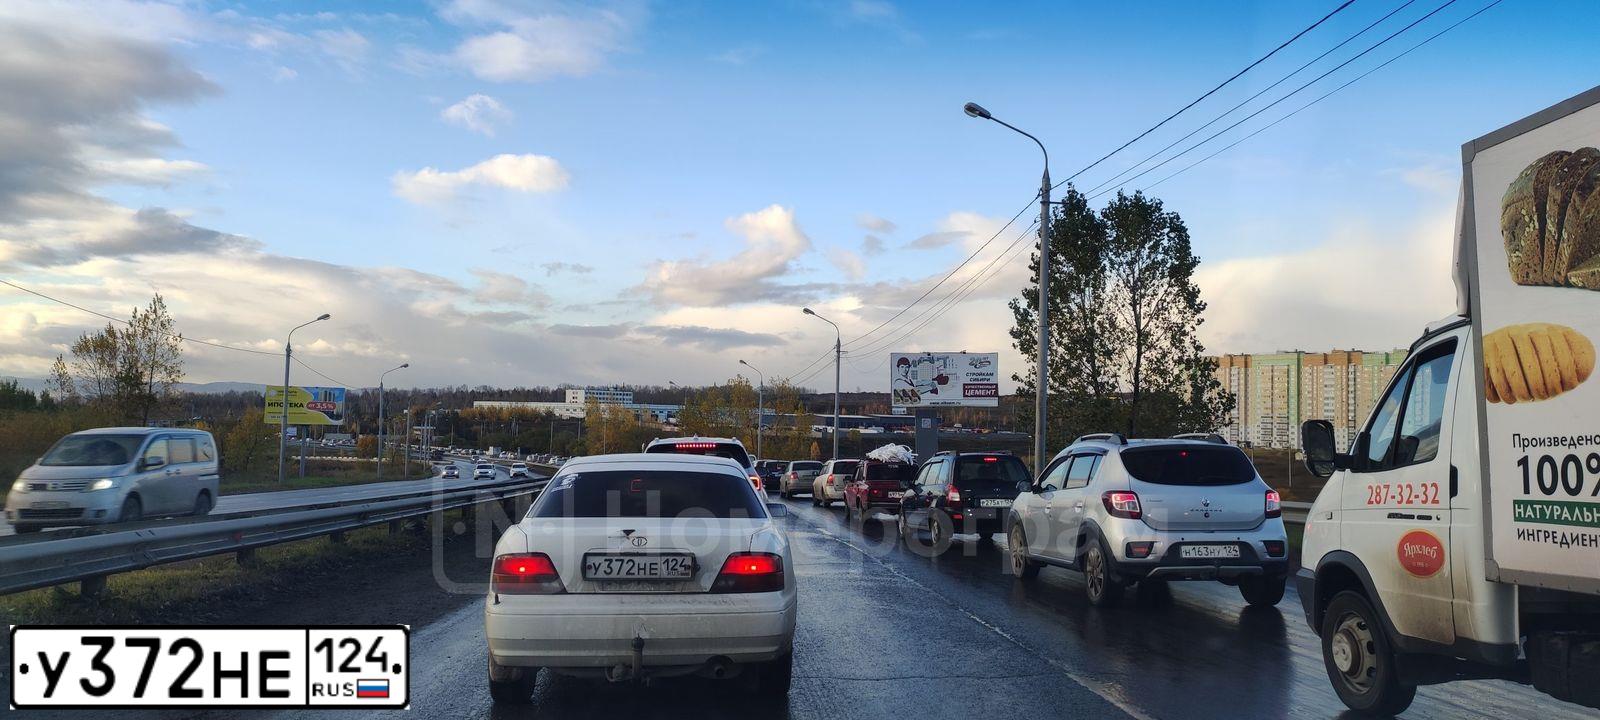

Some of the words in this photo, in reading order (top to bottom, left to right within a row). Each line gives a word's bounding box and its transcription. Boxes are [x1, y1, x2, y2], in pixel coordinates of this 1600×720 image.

[1512, 433, 1600, 452] Произведено
[1367, 482, 1440, 505] 287-32-32
[1517, 528, 1600, 549] ИНГРЕДИЕН
[1184, 546, 1221, 557] Н163НУ
[1223, 545, 1239, 554] 124
[1403, 542, 1438, 559] Ярхлеб
[592, 558, 659, 576] У372НЕ
[662, 558, 688, 572] 124
